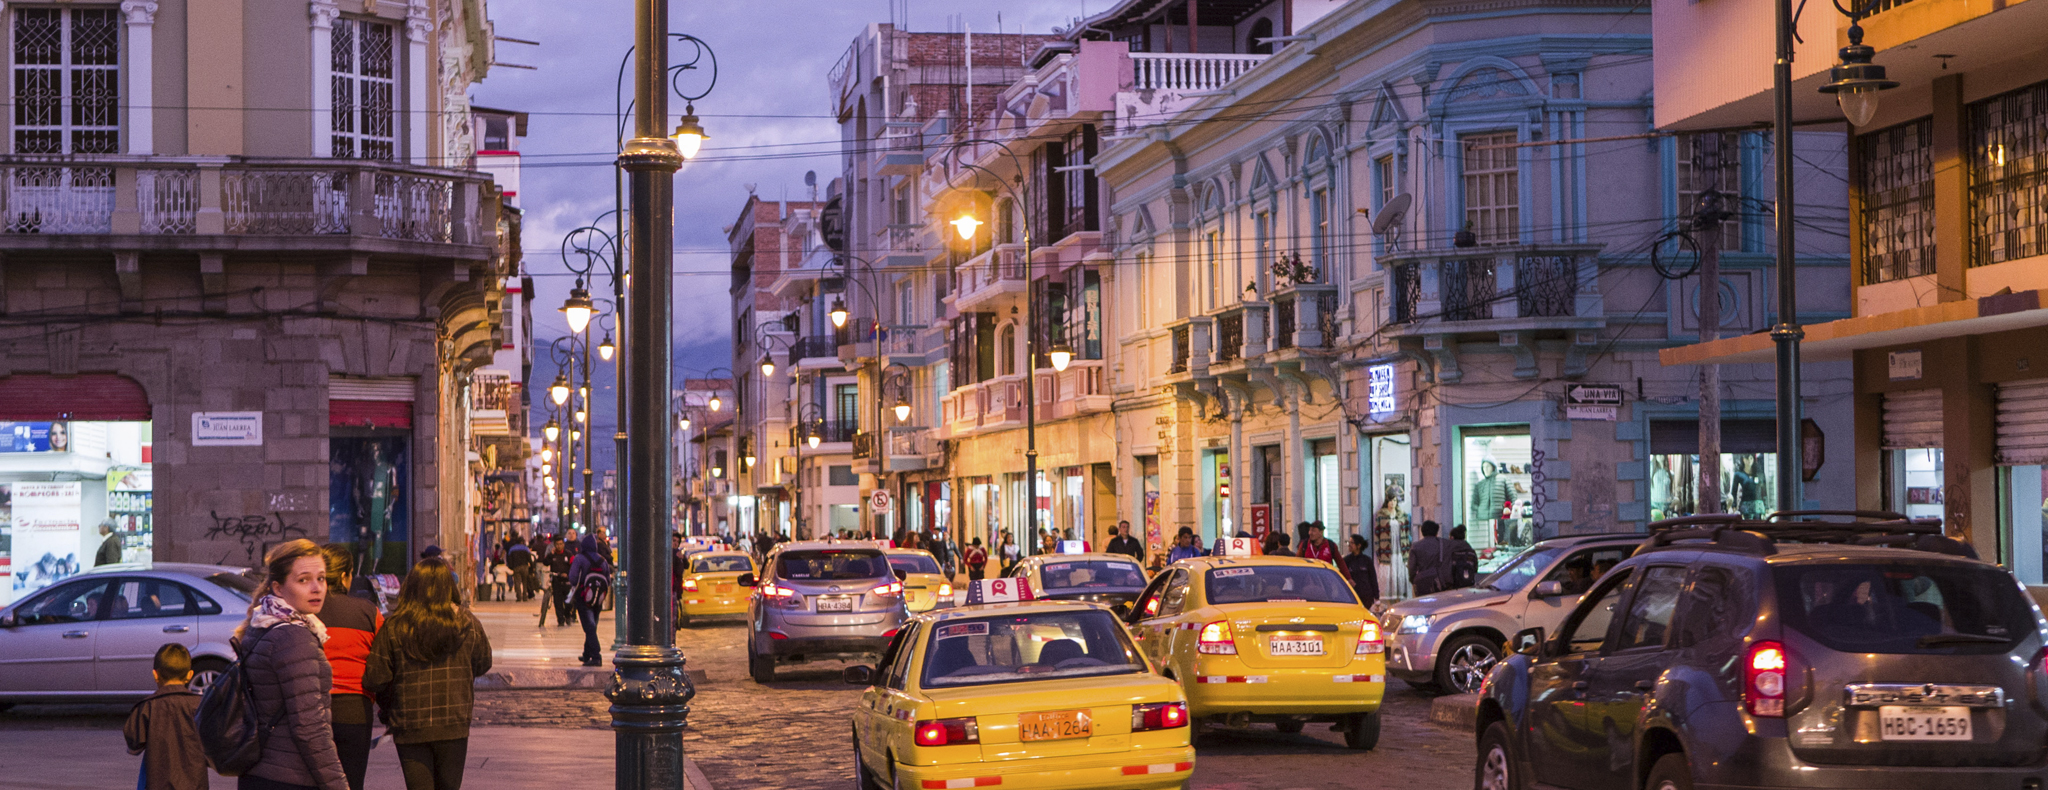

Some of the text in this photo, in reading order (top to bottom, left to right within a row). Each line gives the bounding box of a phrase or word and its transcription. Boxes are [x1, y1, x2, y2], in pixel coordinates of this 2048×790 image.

[1584, 389, 1616, 398] UNA VIA
[952, 623, 985, 633] 1250
[1272, 641, 1322, 653] HAA-3101
[1856, 693, 1997, 704] DUSTER
[1022, 720, 1089, 738] HAA-1264
[1883, 717, 1968, 736] HBC-1659
